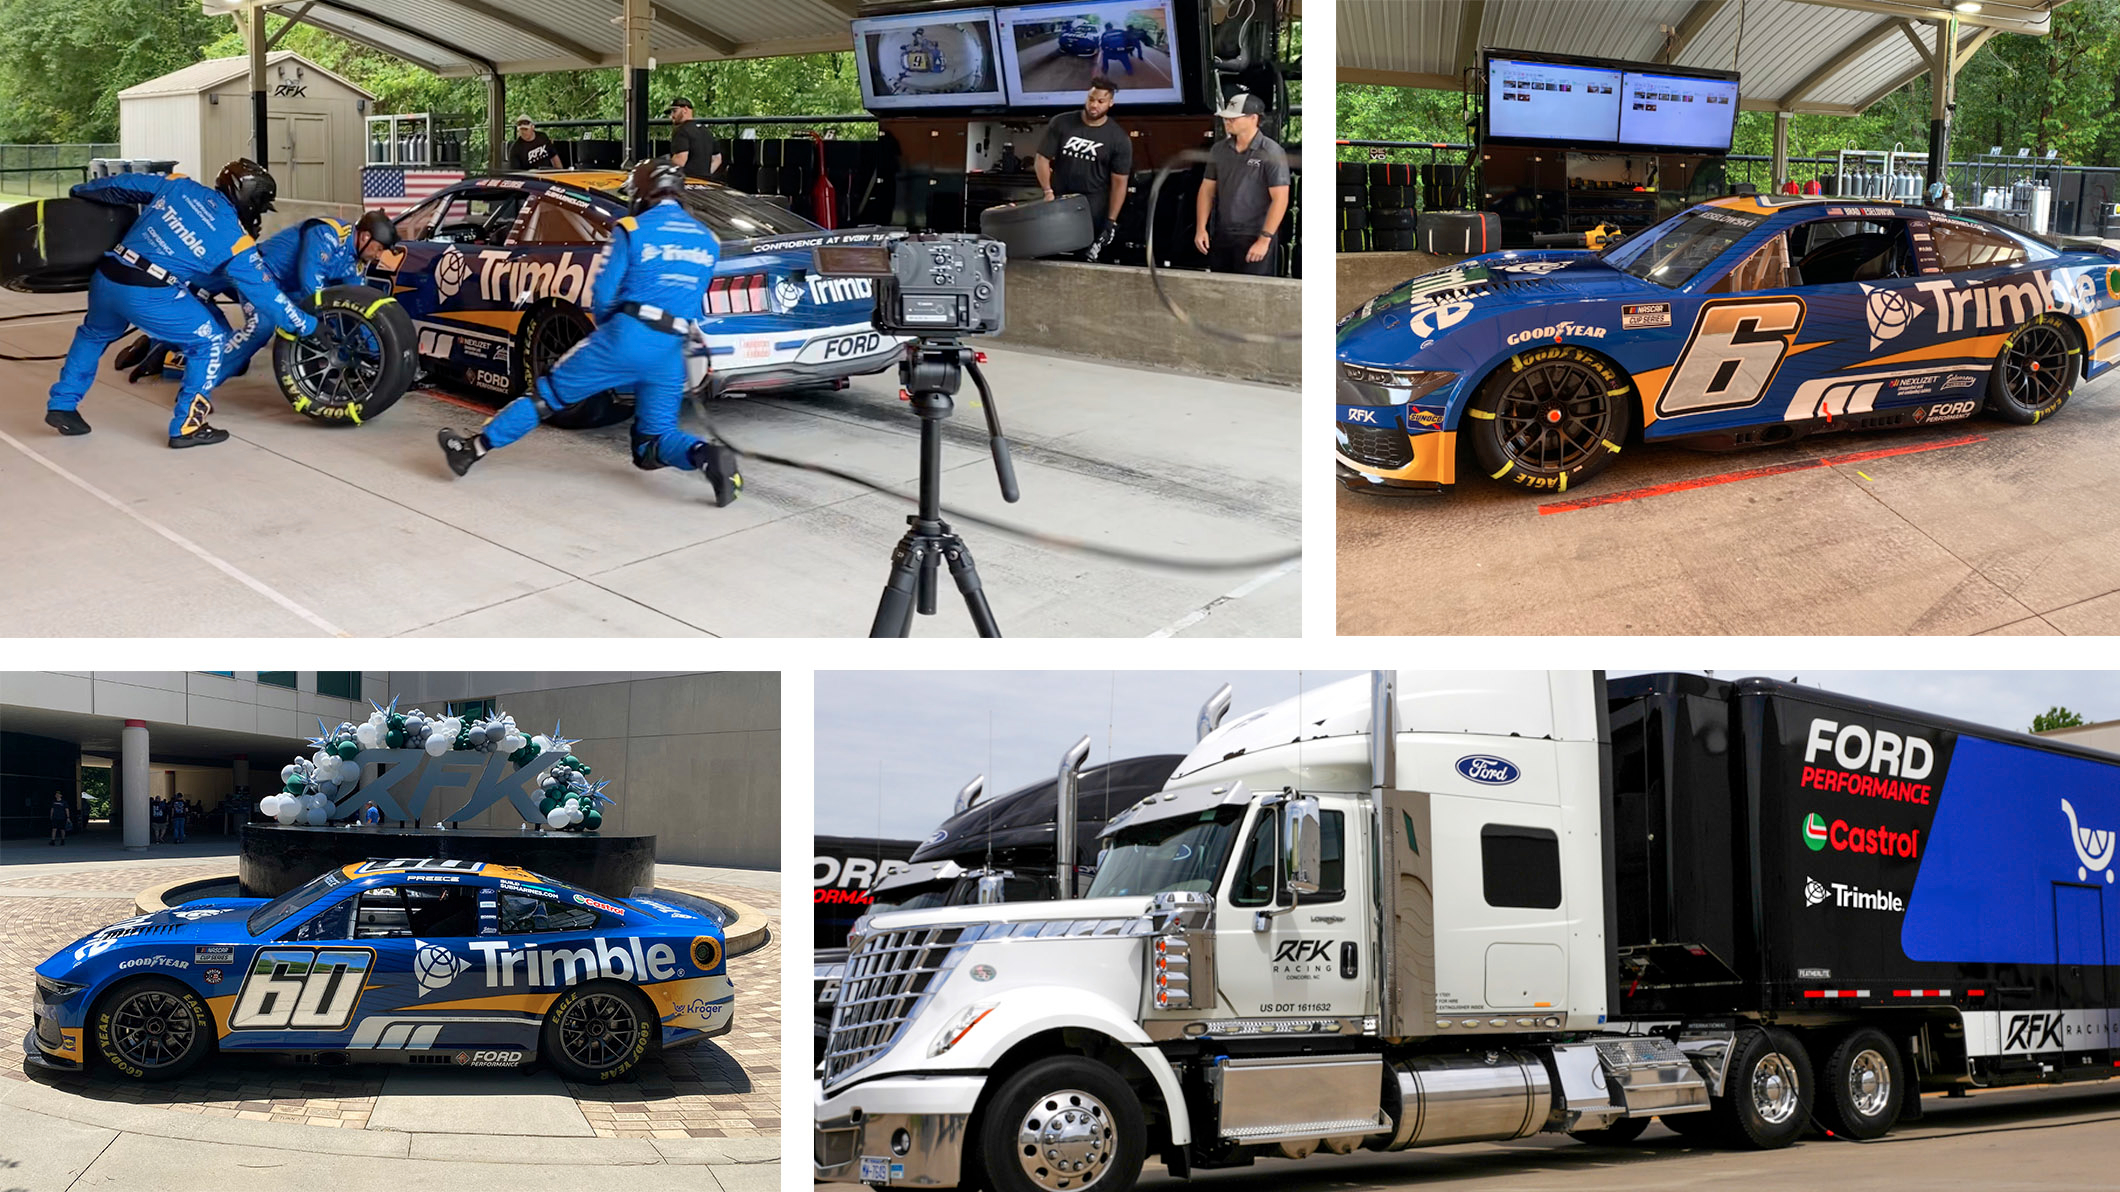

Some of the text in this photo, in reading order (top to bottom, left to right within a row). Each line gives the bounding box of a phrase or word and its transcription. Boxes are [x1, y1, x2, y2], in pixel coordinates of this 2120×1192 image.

[274, 85, 307, 98] RFK
[528, 145, 548, 160] RFK
[1062, 150, 1095, 162] RACING
[1063, 136, 1104, 156] RFK
[161, 204, 207, 260] Trimble
[753, 238, 823, 253] CONFIDENCE
[826, 236, 840, 245] AT
[842, 234, 870, 243] EVERY
[478, 250, 604, 308] Trimbl
[805, 275, 873, 305] Trimb
[333, 299, 374, 319] EAGL
[1637, 305, 1663, 314] NASCAR
[1915, 267, 2097, 334] Trimble
[1629, 315, 1665, 324] CUP SERIES
[824, 333, 880, 360] FORD
[1657, 297, 1805, 419] 6
[477, 370, 509, 388] FORD
[1348, 408, 1378, 424] RFK
[1410, 413, 1444, 423] SUNOCO
[1926, 413, 1971, 423] PERFORMANCE
[1928, 401, 1976, 416] FORD
[1804, 718, 1934, 780] FORD
[1467, 760, 1509, 783] Ford
[331, 748, 568, 824] RFK
[1801, 766, 1932, 805] PERFORMANCE
[1829, 819, 1920, 859] Castrol
[500, 884, 558, 899] SUBMARINES.COM
[814, 889, 874, 905] ORMA
[1831, 882, 1903, 912] Trimble
[585, 898, 625, 916] Castrol
[1272, 940, 1334, 962] RFK
[119, 955, 189, 970] GOODYEAR
[469, 936, 676, 988] Trimble
[1273, 965, 1331, 973] RACING
[228, 946, 375, 1031] 60
[183, 993, 207, 1027] EAGLE
[552, 992, 577, 1024] EAGLE
[687, 999, 722, 1020] Kroger
[1260, 1003, 1331, 1012] US DOT 1611632
[2004, 1014, 2065, 1050] RFK
[2066, 1024, 2118, 1035] RACING
[473, 1051, 522, 1062] FORD
